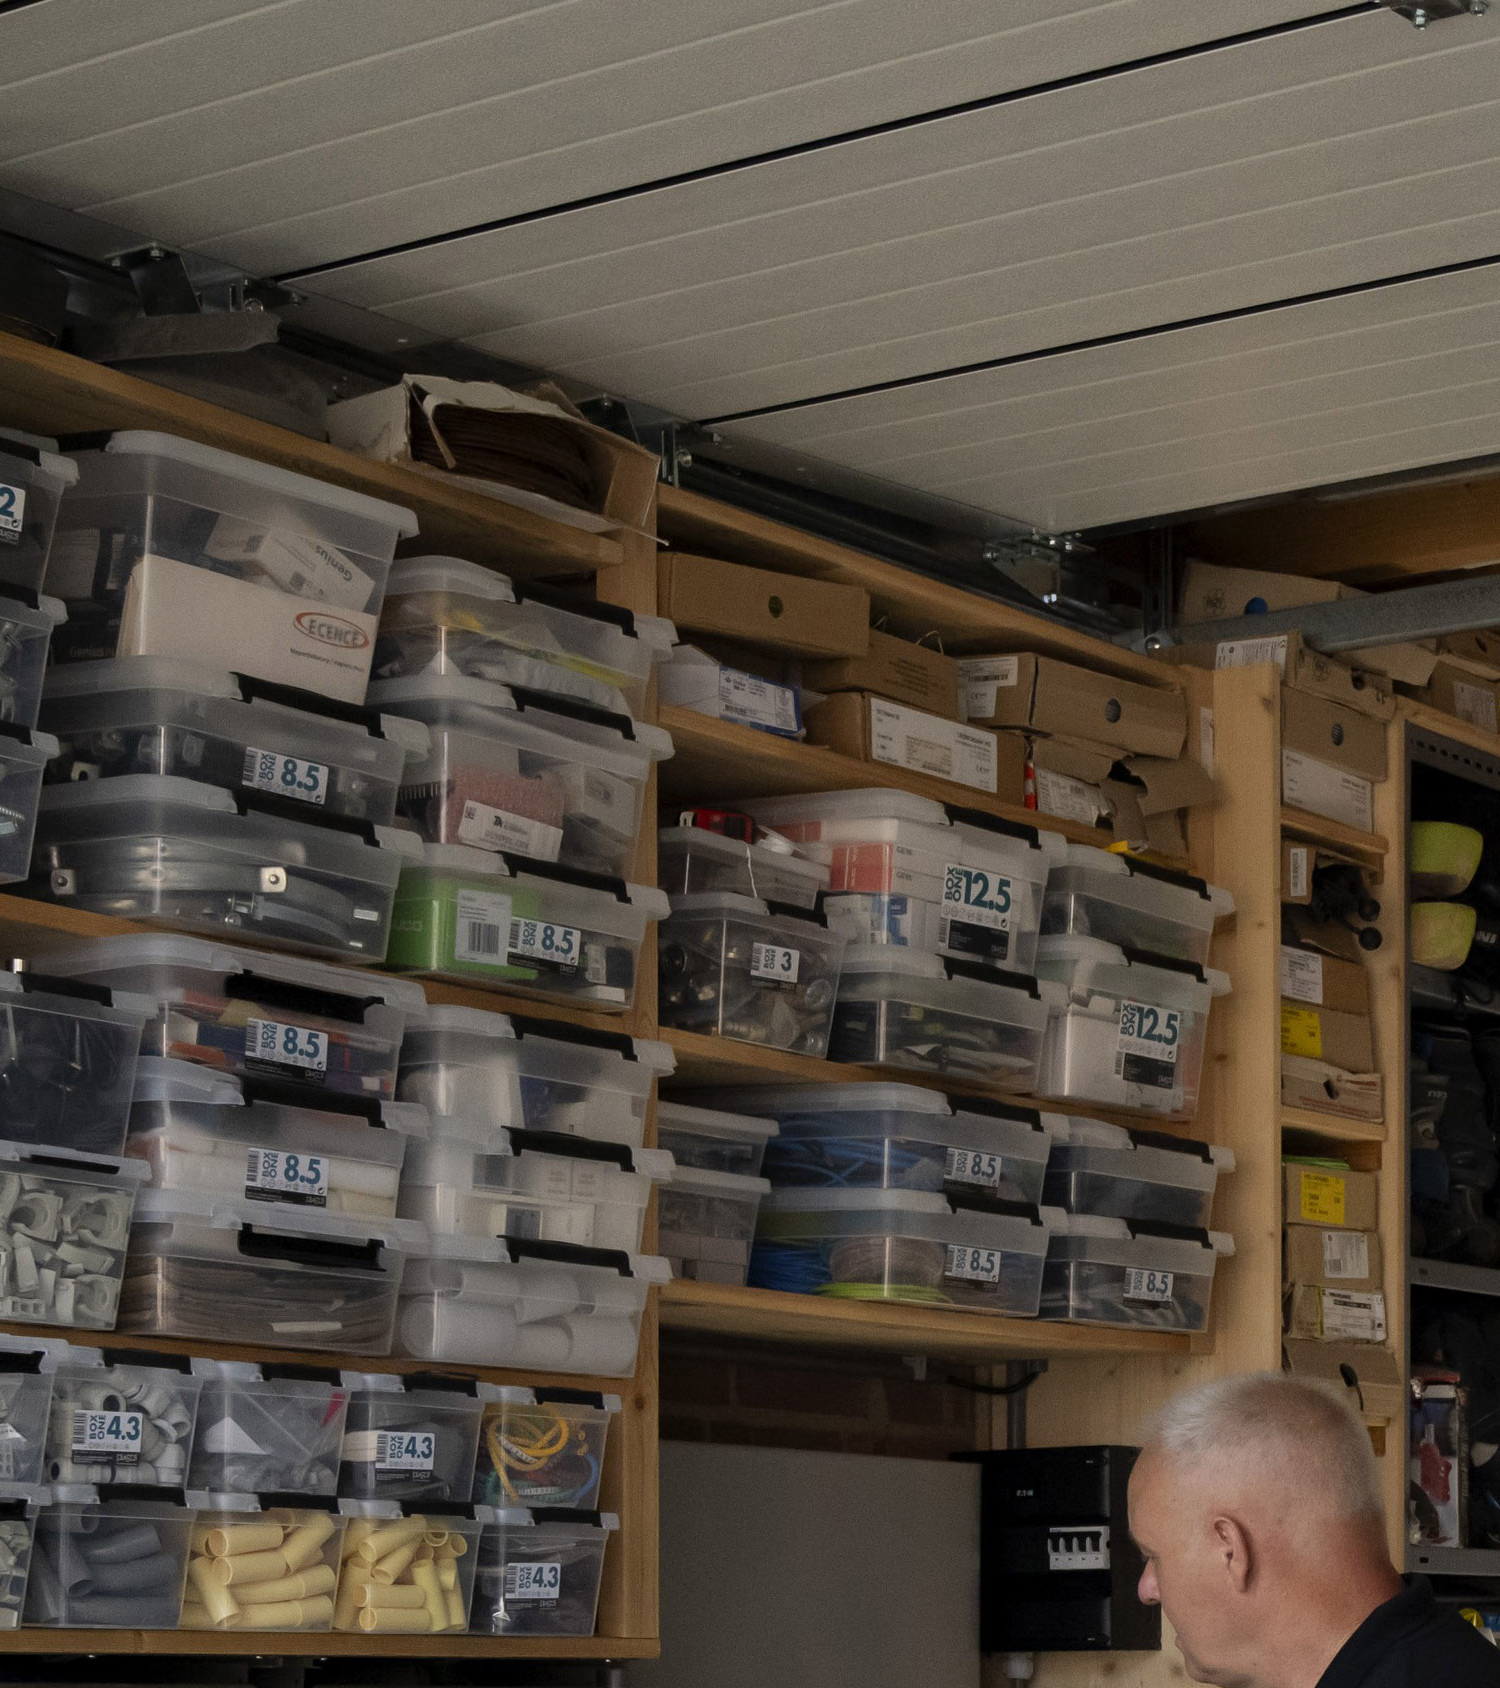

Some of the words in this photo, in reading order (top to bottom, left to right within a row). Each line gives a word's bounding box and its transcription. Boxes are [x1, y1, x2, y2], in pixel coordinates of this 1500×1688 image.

[315, 543, 353, 582] Genius
[308, 618, 360, 646] ECENCE
[259, 752, 270, 779] BOX
[266, 754, 277, 780] ONE
[281, 759, 319, 792] 8.5
[945, 866, 956, 900] BOX
[952, 867, 965, 902] ONE
[963, 870, 1012, 914] 12.5
[522, 921, 532, 945] BOX
[529, 921, 538, 946] ONE
[541, 925, 573, 955] 8.5
[780, 951, 792, 972] 3
[1120, 1003, 1130, 1035] BOX
[1127, 1003, 1138, 1036] ONE
[1136, 1005, 1178, 1046] 12.5
[261, 1022, 271, 1049] BOX
[268, 1023, 278, 1050] ONE
[282, 1027, 320, 1059] 8.5
[262, 1151, 271, 1177] BOX
[269, 1152, 279, 1178] ONE
[283, 1154, 321, 1184] 8.5
[971, 1153, 996, 1178] 8.5
[970, 1249, 995, 1274] 8.5
[1146, 1272, 1168, 1294] 8.5
[89, 1414, 98, 1439] BOX
[97, 1414, 107, 1440] ONE
[107, 1415, 140, 1441] 4.3
[389, 1435, 397, 1458] BOX
[396, 1435, 404, 1459] ONE
[404, 1436, 433, 1459] 4.3
[532, 1566, 559, 1588] 4.3
